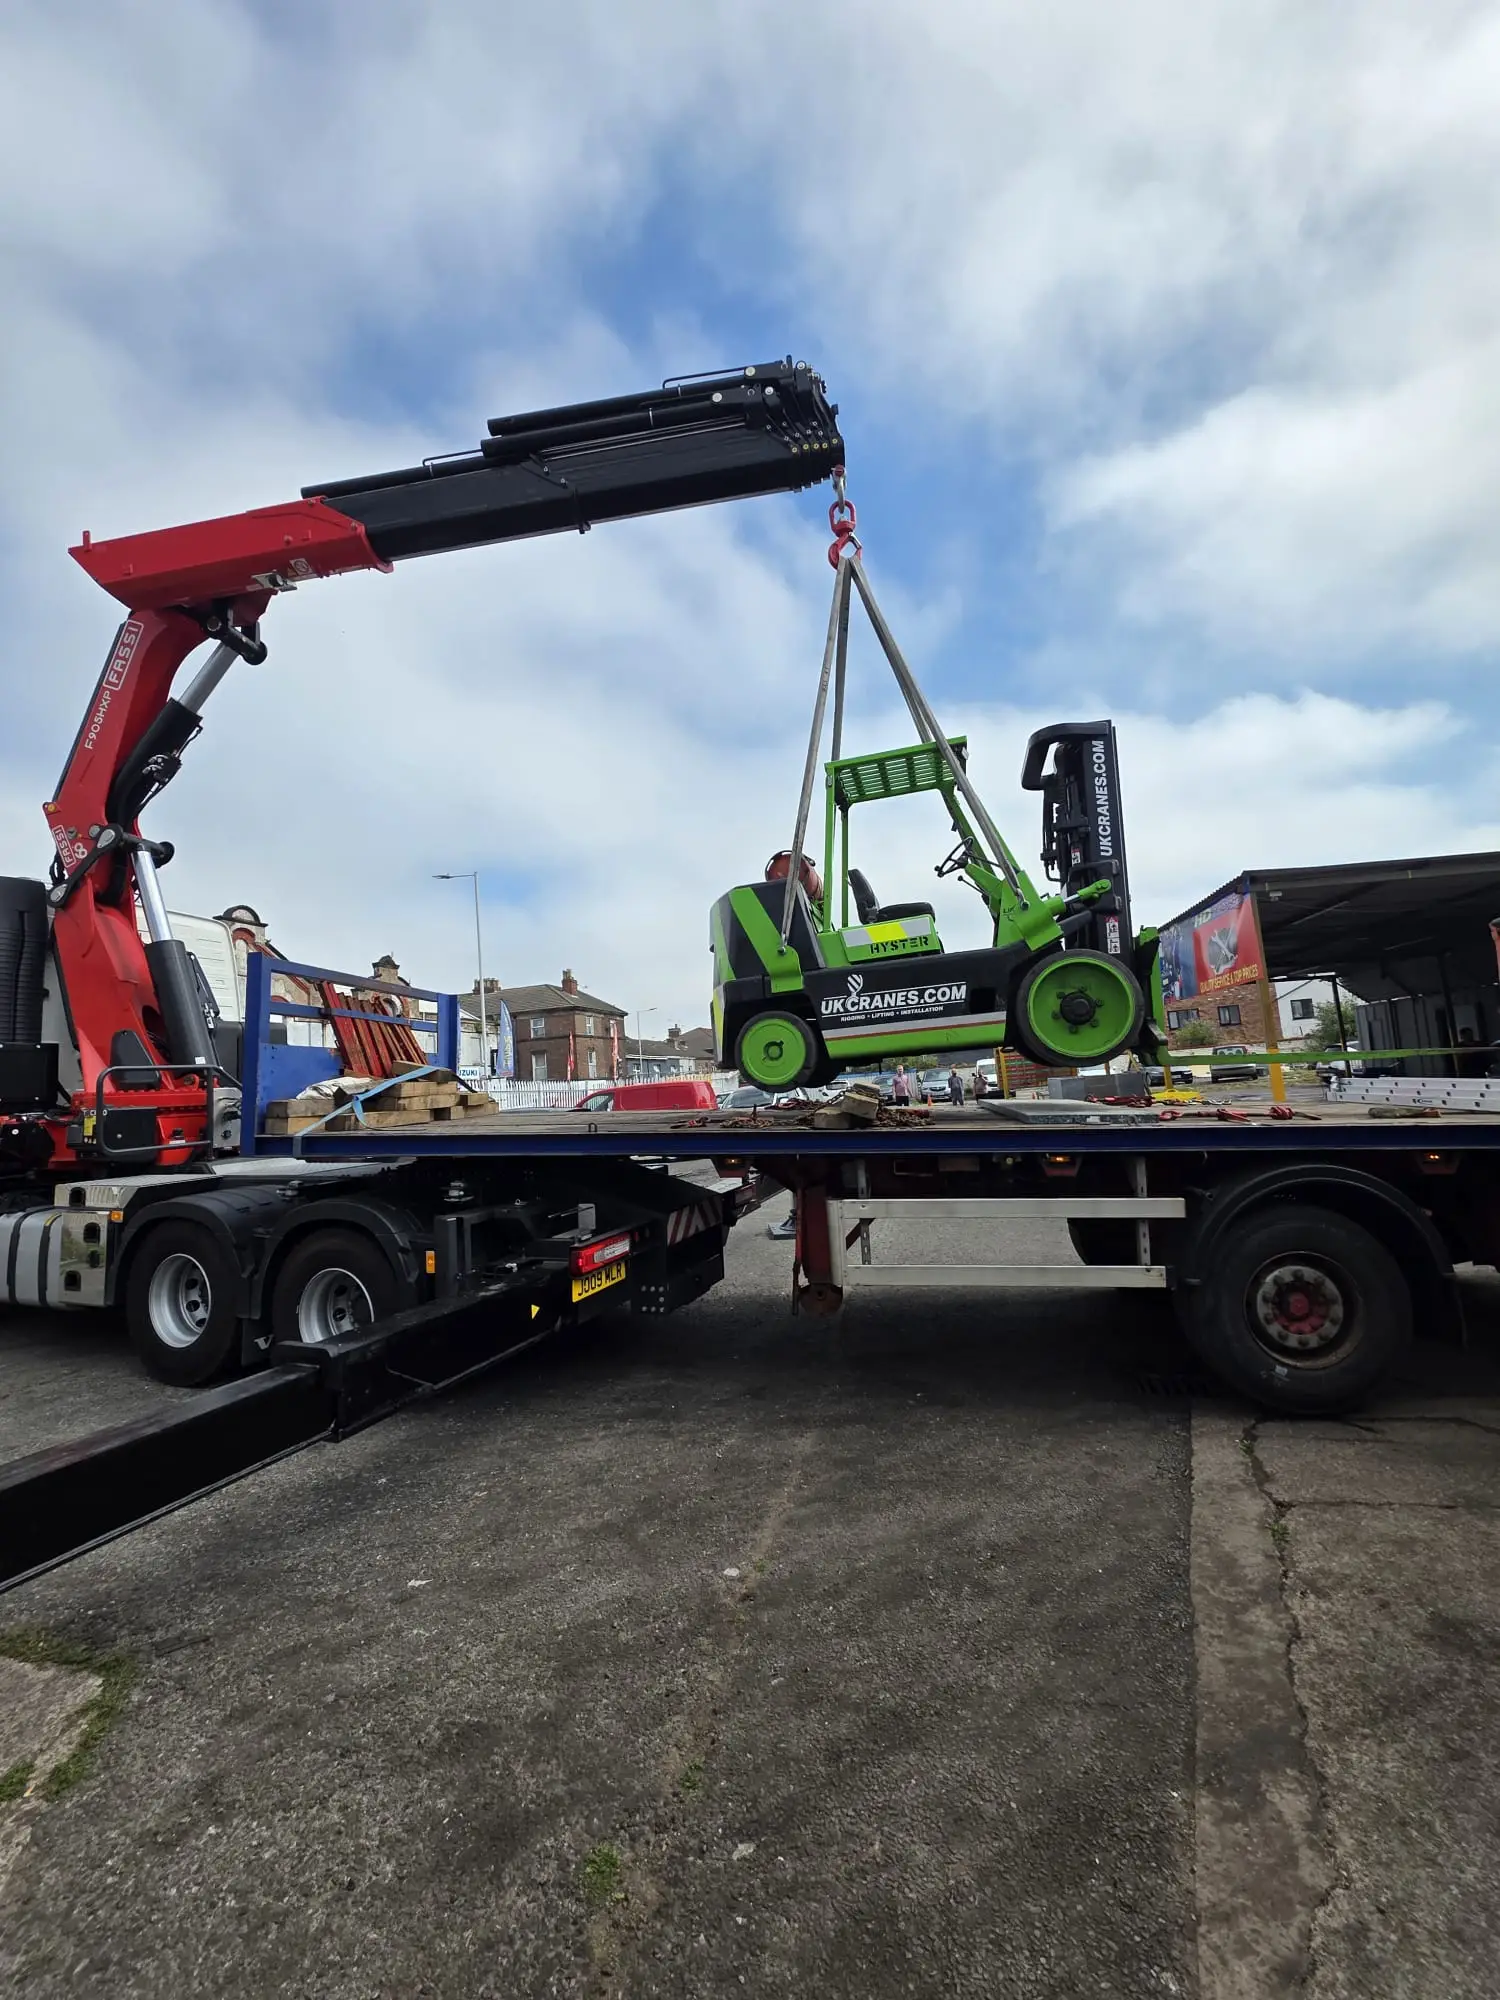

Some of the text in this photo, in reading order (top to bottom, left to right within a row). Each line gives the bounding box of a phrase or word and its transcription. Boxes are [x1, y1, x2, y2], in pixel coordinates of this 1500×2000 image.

[108, 626, 139, 684] FASSI
[84, 690, 112, 750] F905HXP
[1091, 740, 1113, 857] UKCRANES.COM
[55, 829, 73, 863] FASSI
[870, 936, 929, 954] HYSTER
[1214, 973, 1230, 989] SERVICE
[1242, 963, 1258, 979] PRICES
[821, 984, 967, 1015] UKCRANES.COM
[840, 1006, 944, 1022] RIGGING LIFTING INSTALLATION
